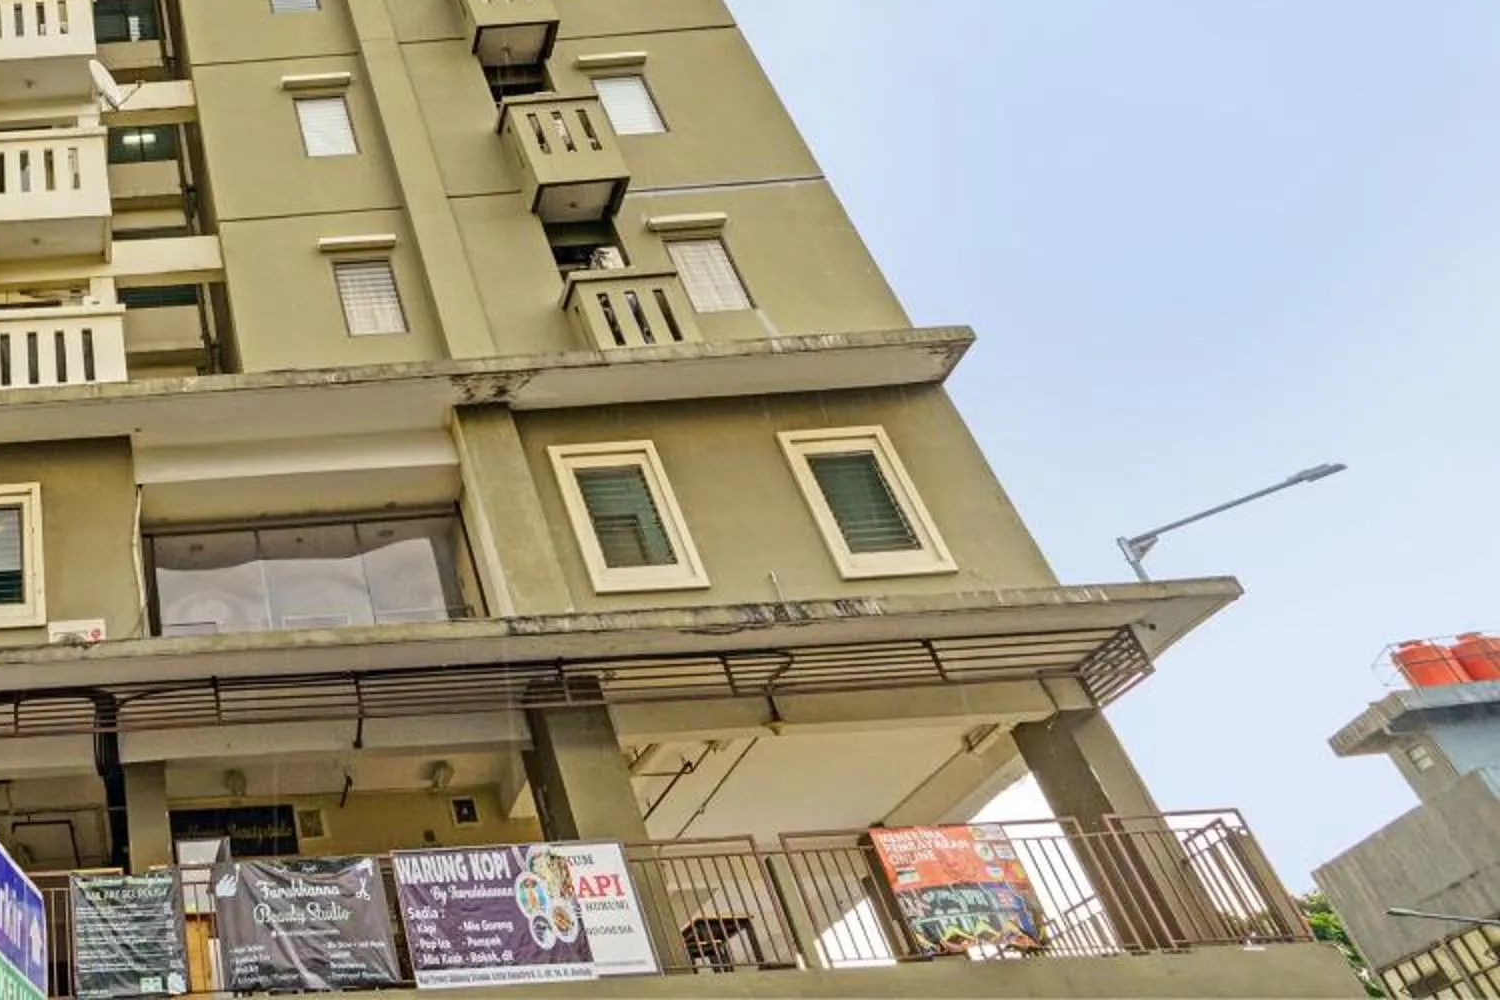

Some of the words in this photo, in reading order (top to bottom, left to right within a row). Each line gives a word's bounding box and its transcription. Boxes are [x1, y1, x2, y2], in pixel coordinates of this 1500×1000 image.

[395, 853, 468, 885] WARUNG
[468, 851, 512, 880] KOPI
[253, 902, 306, 925] Beauty
[306, 901, 350, 922] Studio
